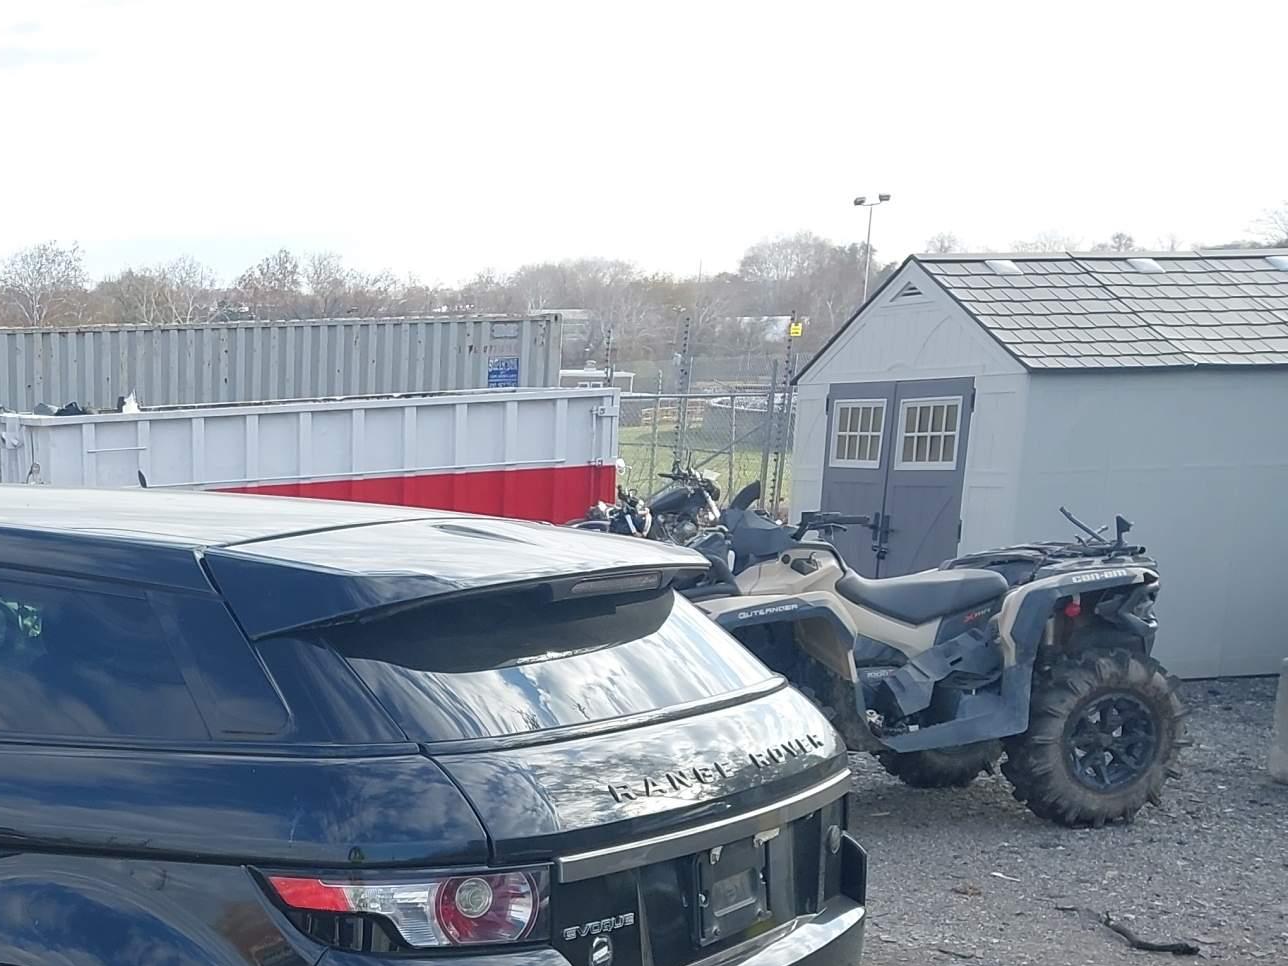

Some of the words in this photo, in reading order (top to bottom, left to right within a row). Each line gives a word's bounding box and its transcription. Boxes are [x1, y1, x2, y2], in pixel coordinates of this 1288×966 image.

[1071, 569, 1128, 583] can-am
[737, 604, 799, 620] OUTLANDER
[606, 758, 737, 804] RANGE
[747, 733, 825, 769] ROVER
[562, 911, 635, 942] EVOQUE
